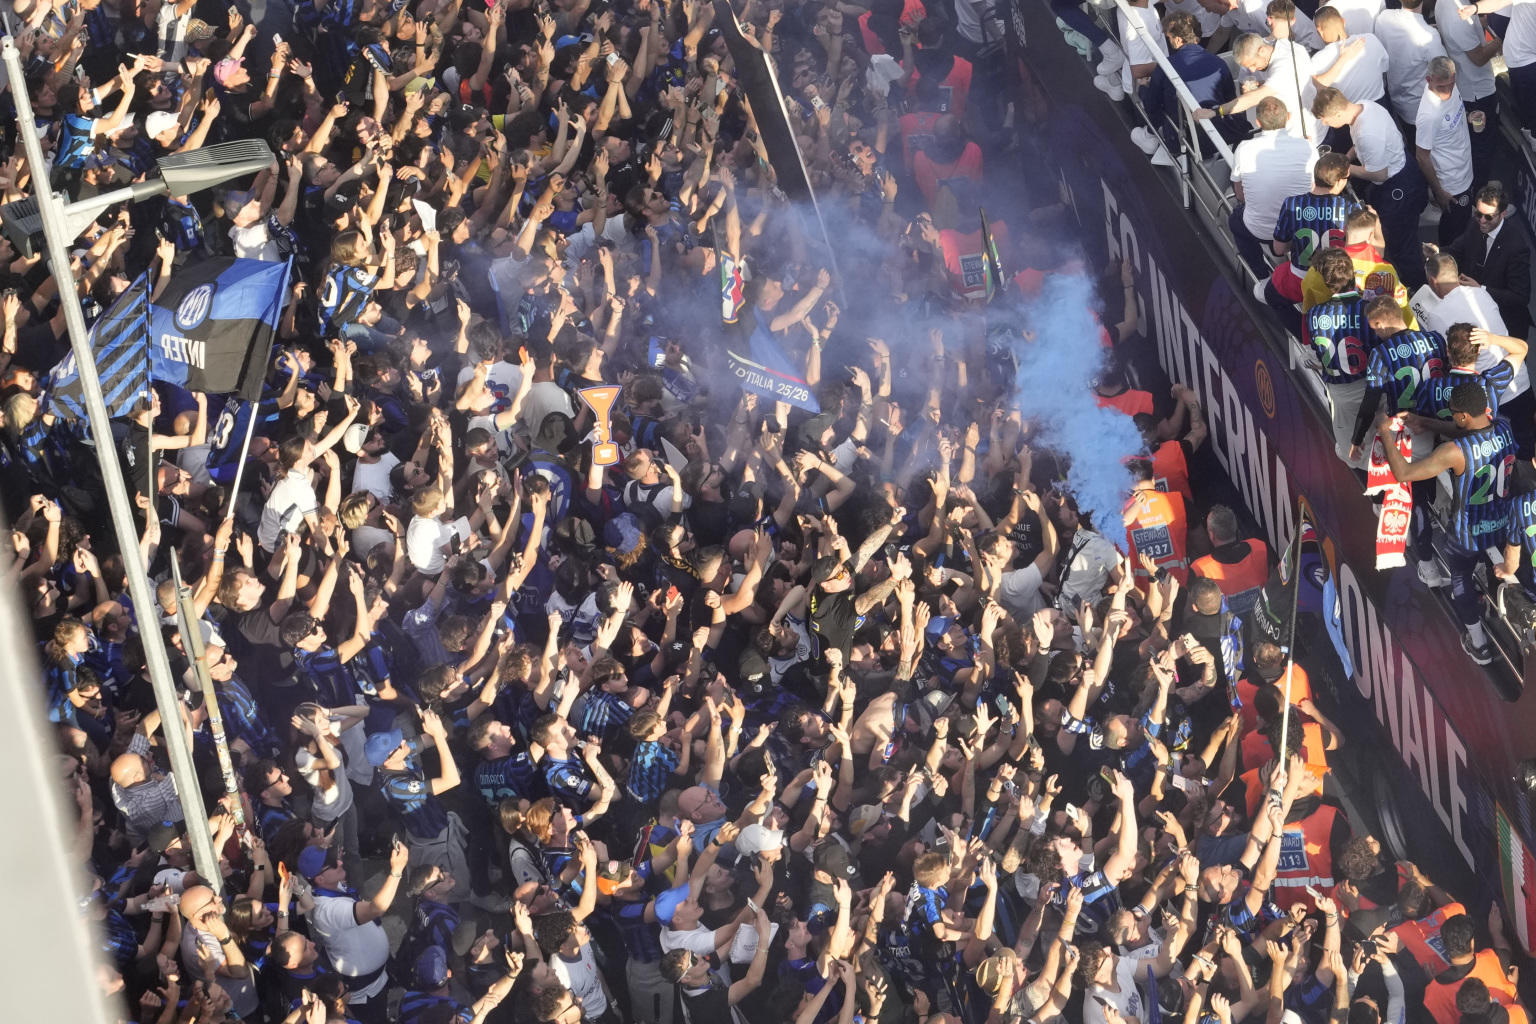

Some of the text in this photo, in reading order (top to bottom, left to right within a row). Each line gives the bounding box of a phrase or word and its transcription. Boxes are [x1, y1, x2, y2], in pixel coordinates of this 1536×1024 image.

[1295, 205, 1345, 222] DOUBLE
[1312, 314, 1361, 331] DOUBLE
[1315, 335, 1368, 376] 26
[1388, 335, 1439, 362] DOUBLE
[775, 383, 810, 403] 25/26
[1133, 526, 1168, 546] STEWARD
[1148, 252, 1476, 873] INTERNAONALE
